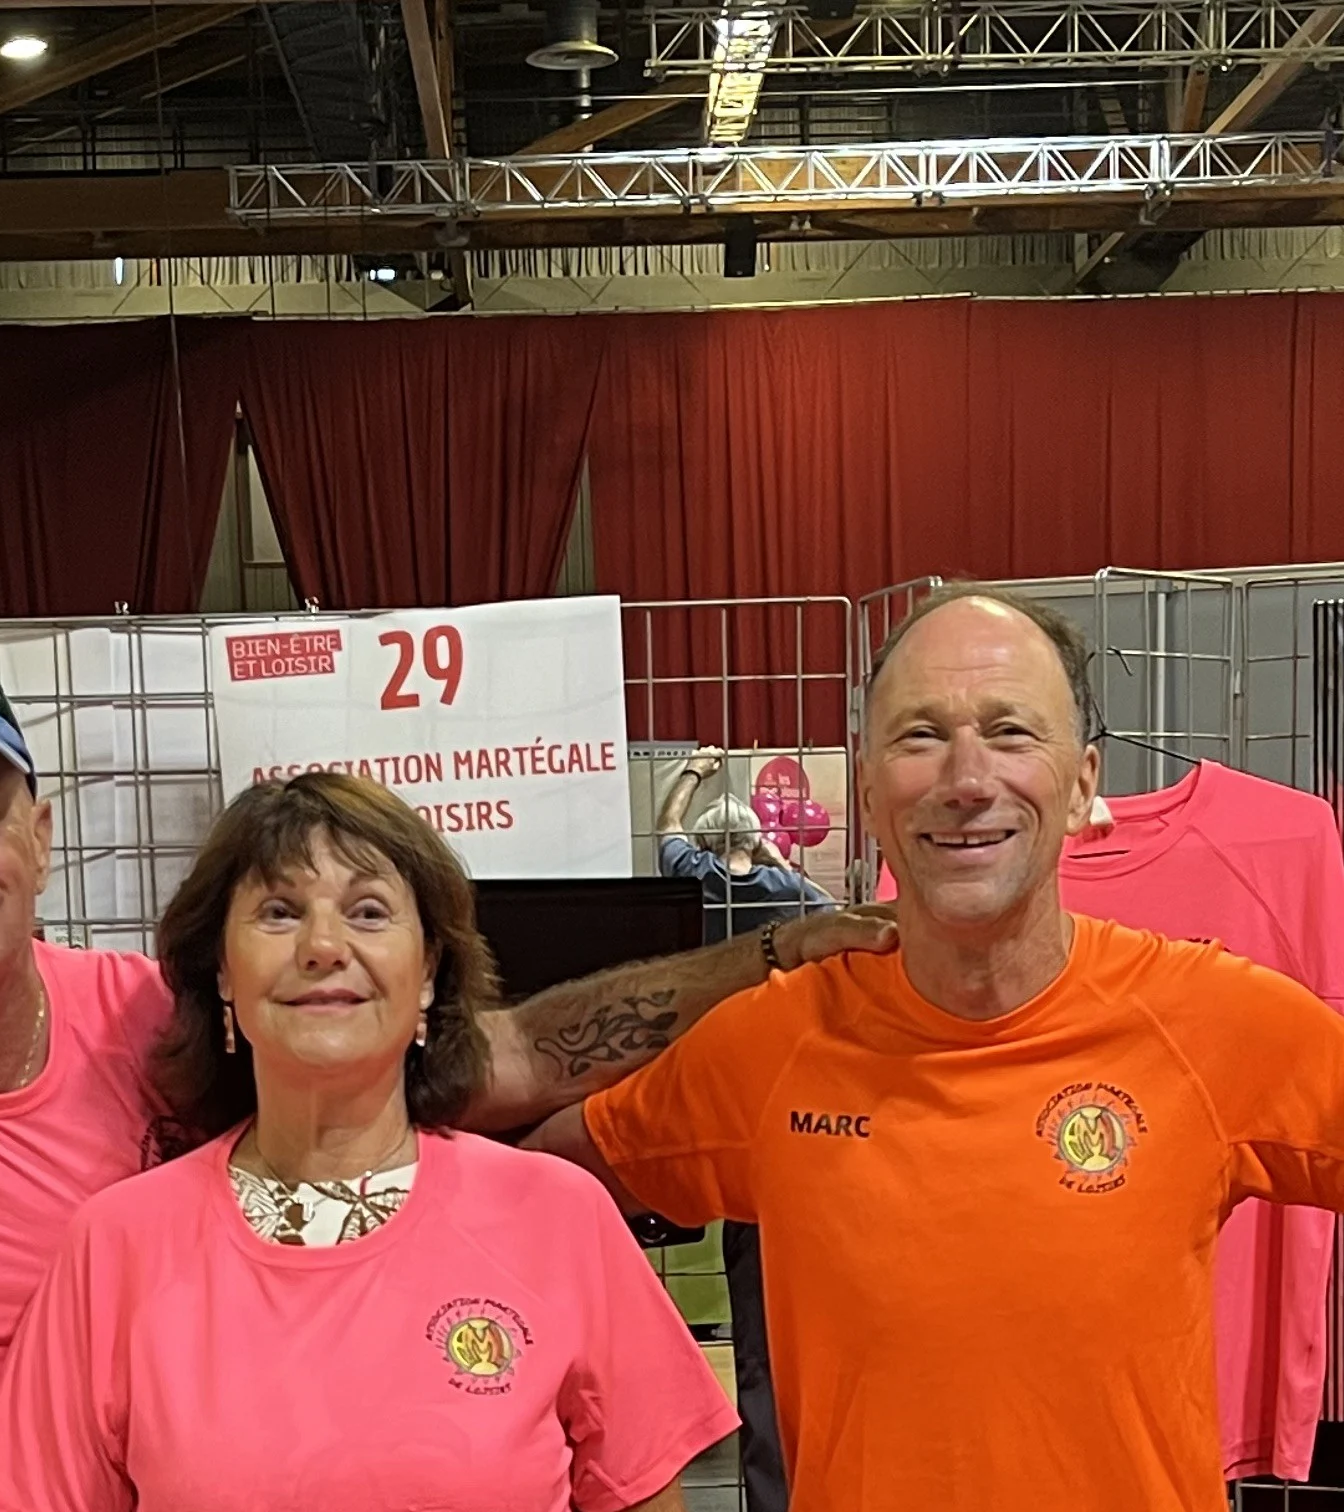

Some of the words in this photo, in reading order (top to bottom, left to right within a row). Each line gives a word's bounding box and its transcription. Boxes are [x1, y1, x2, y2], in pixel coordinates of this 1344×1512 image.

[232, 633, 338, 659] BIEN-ÊTRE
[234, 660, 257, 679] ET
[260, 655, 332, 677] LOISIR
[378, 625, 464, 711] 29
[453, 737, 617, 781] MARTÉGALE
[416, 799, 515, 833] OISIRS
[790, 1110, 871, 1138] MARC
